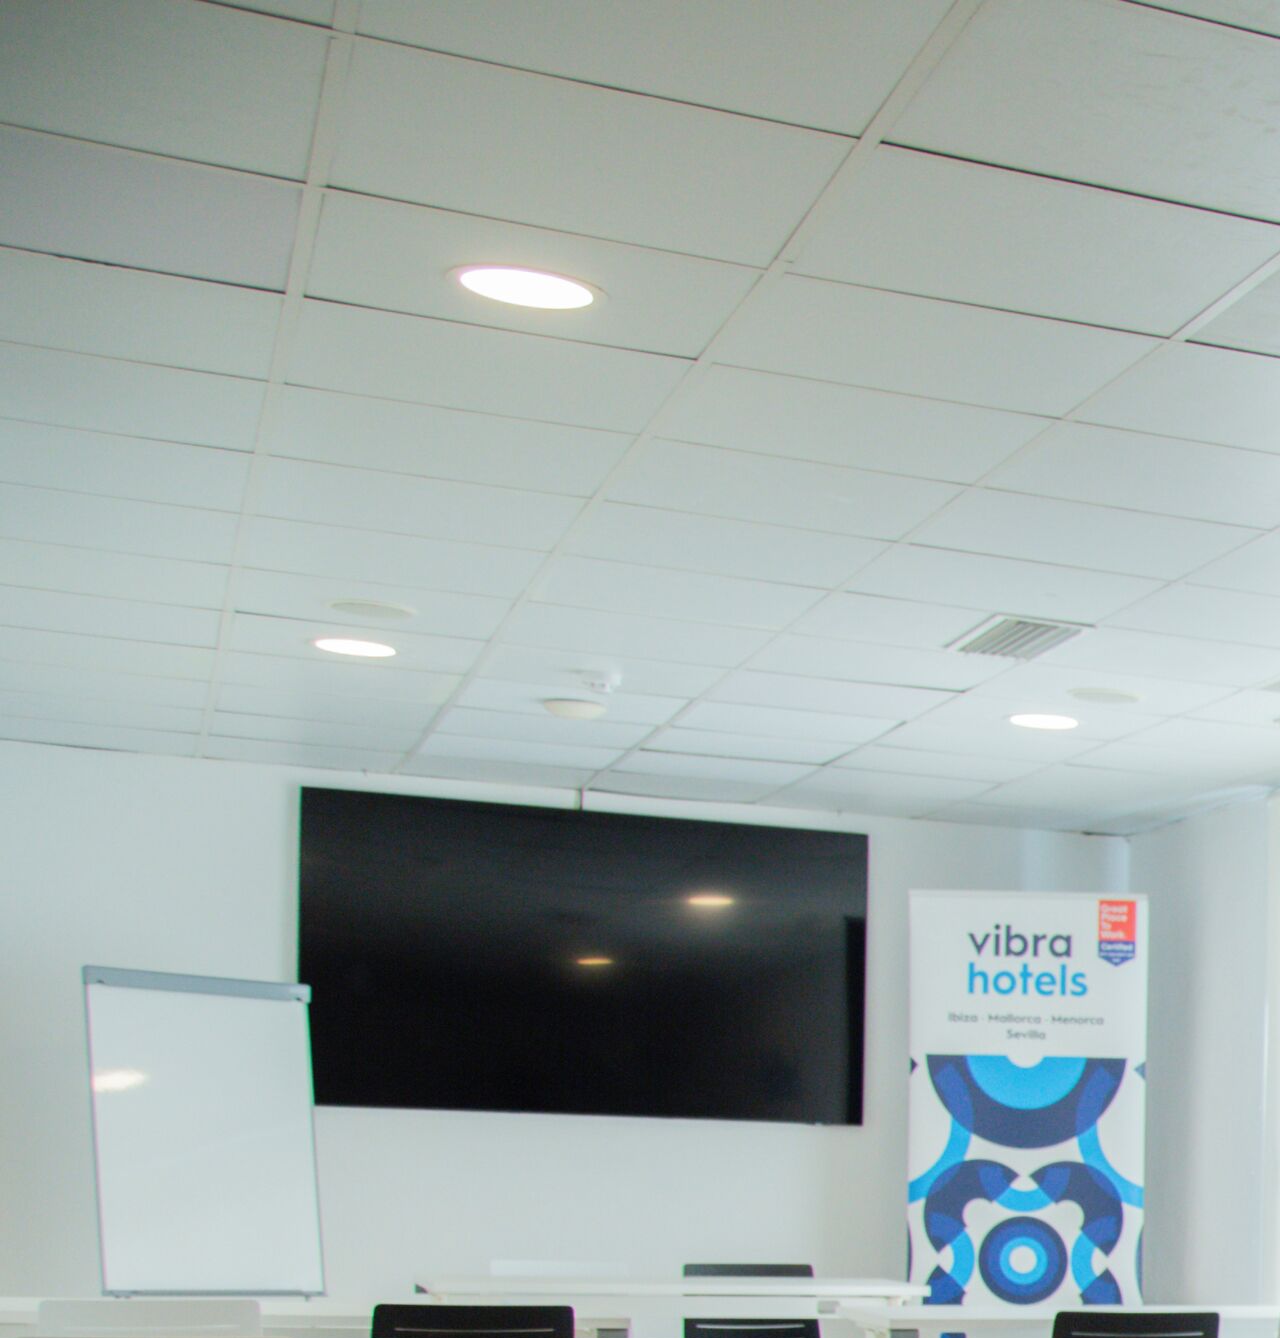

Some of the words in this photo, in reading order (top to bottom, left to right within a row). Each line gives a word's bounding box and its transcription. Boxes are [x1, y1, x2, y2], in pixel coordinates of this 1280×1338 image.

[968, 923, 1072, 957] vibra
[967, 962, 1088, 996] hotels
[948, 1012, 978, 1023] Ibiza
[987, 1013, 1042, 1025] Mallorca
[1051, 1014, 1105, 1026] Menorca
[1006, 1028, 1046, 1040] Sevilla
